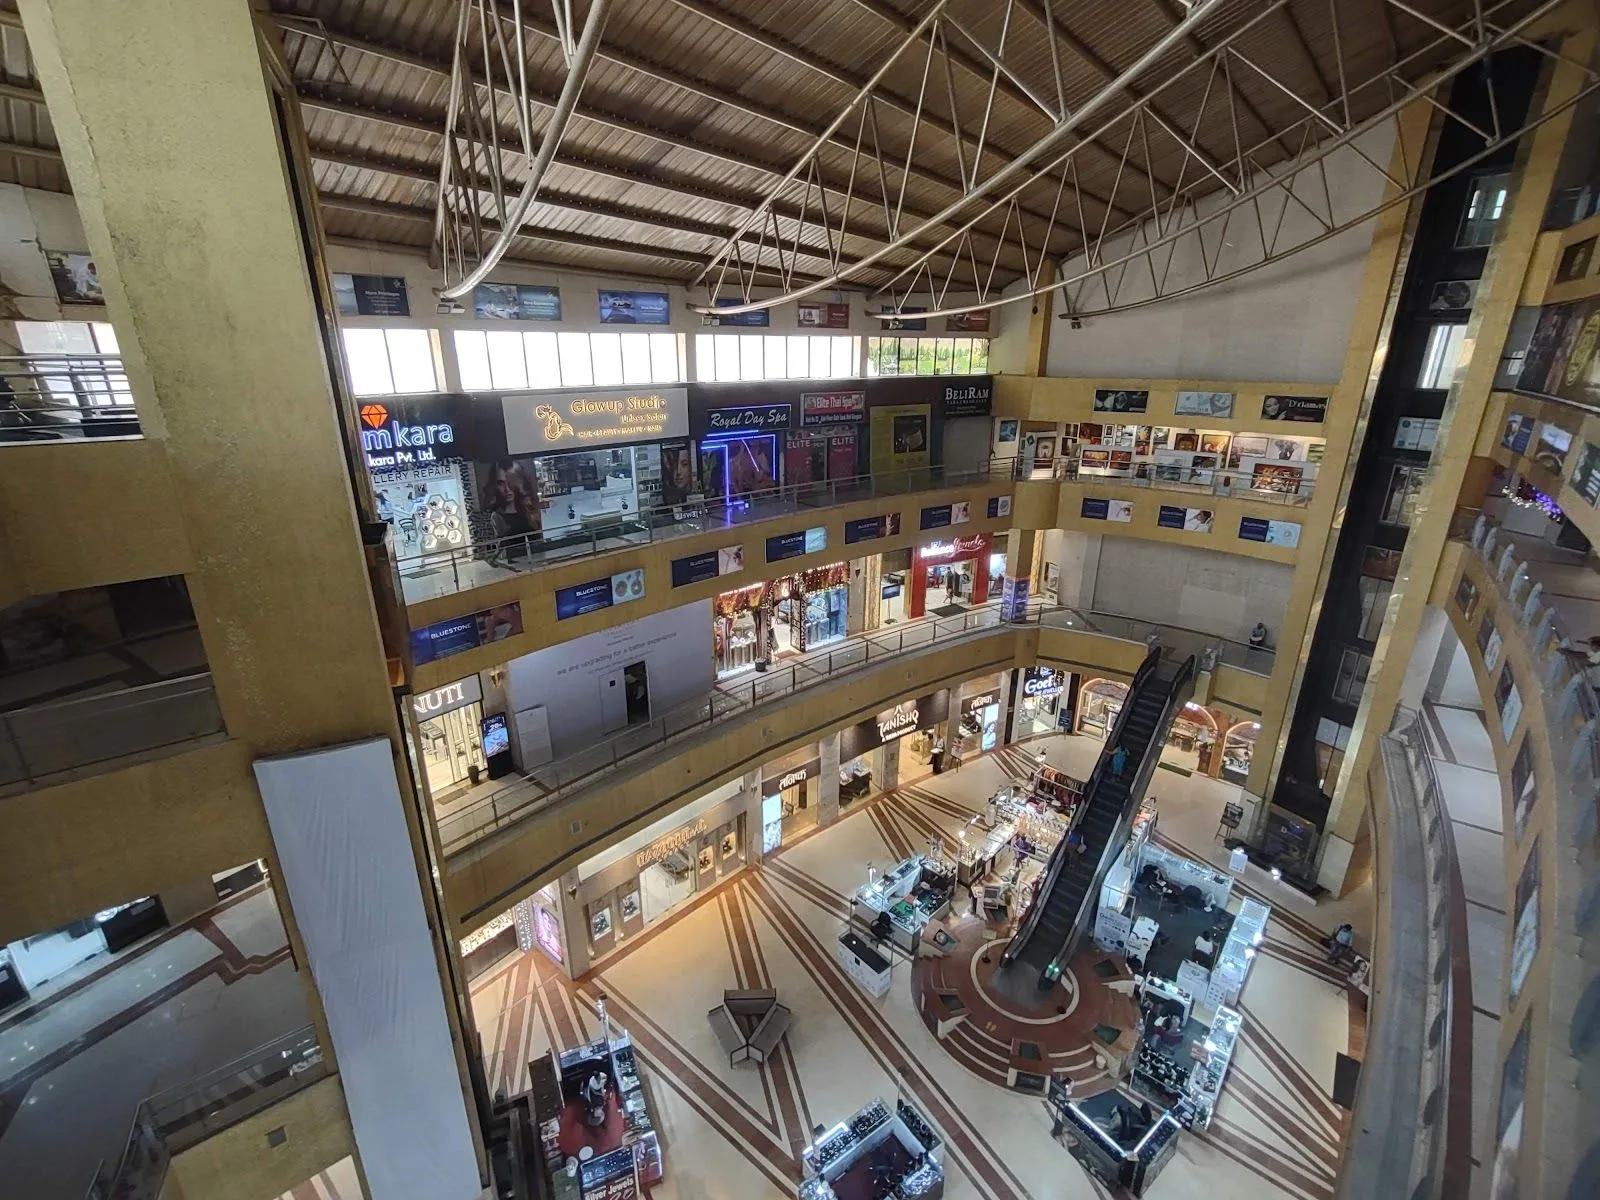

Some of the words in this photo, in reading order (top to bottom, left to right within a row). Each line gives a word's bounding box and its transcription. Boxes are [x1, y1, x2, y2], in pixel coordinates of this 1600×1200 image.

[571, 399, 624, 414] Glowup
[628, 395, 667, 409] Studio
[711, 413, 742, 429] Royal
[744, 411, 765, 426] Day
[767, 409, 788, 425] Spa
[787, 440, 811, 449] ELITE
[832, 437, 855, 445] ELITE
[368, 454, 394, 467] kara
[396, 452, 416, 463] Pvt.
[417, 447, 436, 461] Ltd.
[413, 467, 451, 479] REPAIR
[430, 622, 472, 640] BLUESTONE
[877, 709, 919, 738] TANISHQ
[779, 769, 807, 790] तनिष्क
[609, 1177, 634, 1195] Jewels
